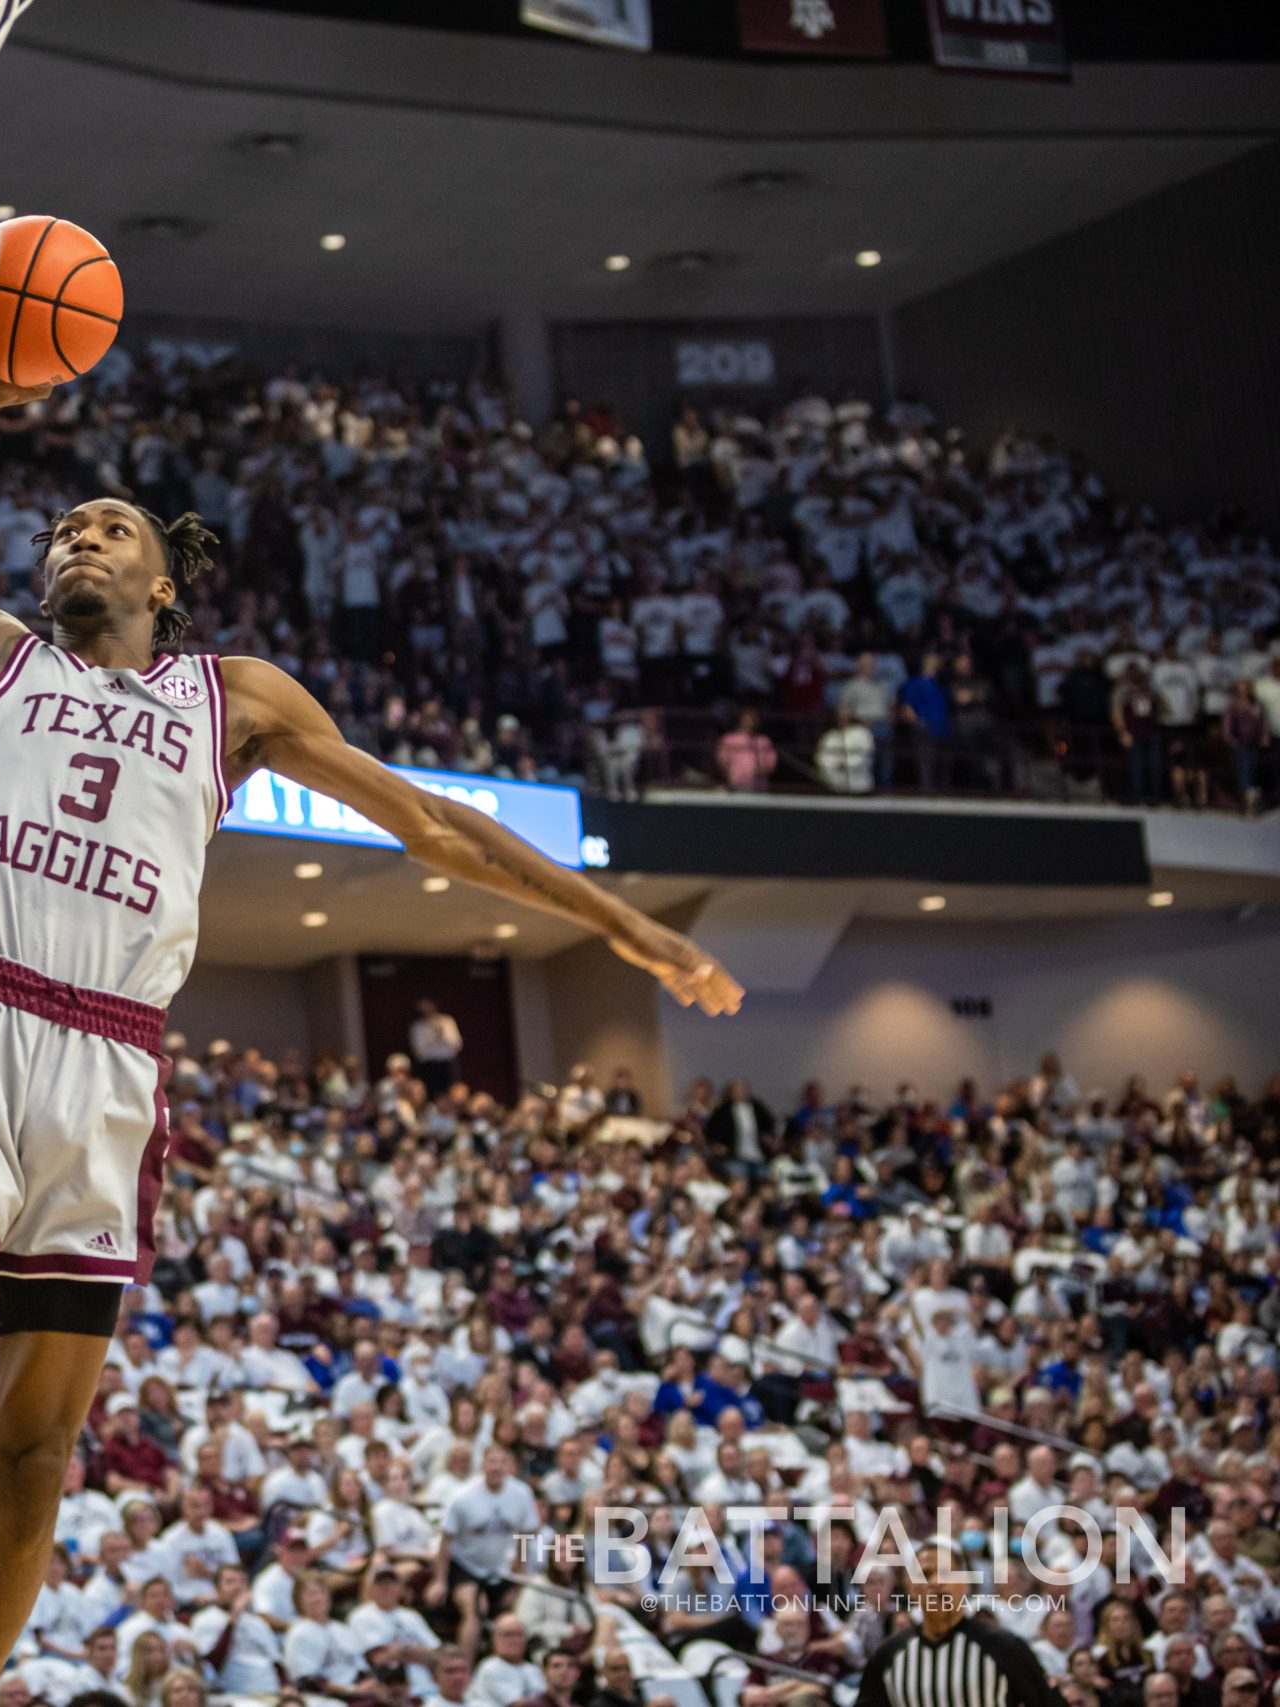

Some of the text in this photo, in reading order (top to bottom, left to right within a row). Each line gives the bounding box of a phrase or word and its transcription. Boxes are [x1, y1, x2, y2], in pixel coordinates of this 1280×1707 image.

[161, 675, 198, 699] SEC
[21, 693, 193, 773] TEXAS
[58, 752, 121, 823] 3
[85, 1242, 118, 1256] adidas
